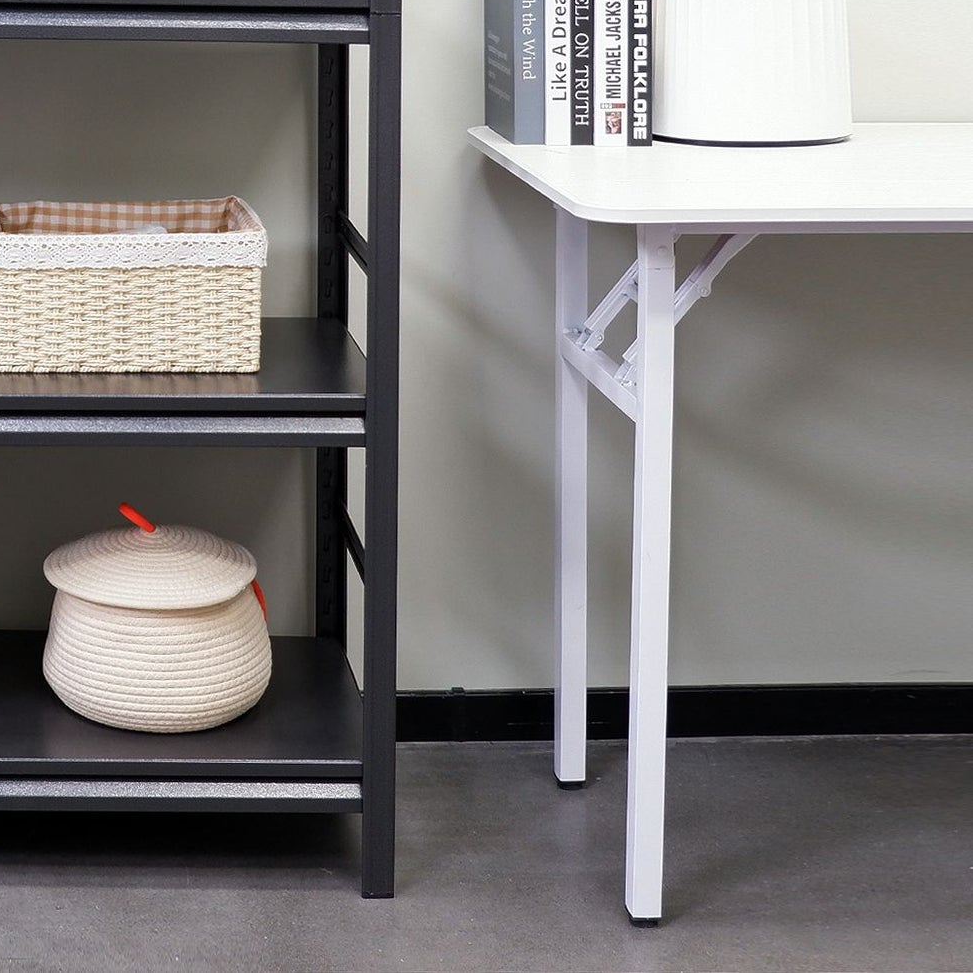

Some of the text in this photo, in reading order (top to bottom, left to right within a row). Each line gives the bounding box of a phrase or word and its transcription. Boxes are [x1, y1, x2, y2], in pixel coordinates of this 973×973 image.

[522, 13, 537, 35] the
[522, 39, 537, 80] Wind
[552, 44, 567, 57] A
[574, 32, 590, 59] ON
[551, 62, 567, 101] Like
[605, 45, 622, 99] MICHAEL
[633, 33, 648, 140] FOLKLORE
[574, 66, 590, 126] TRUTH
